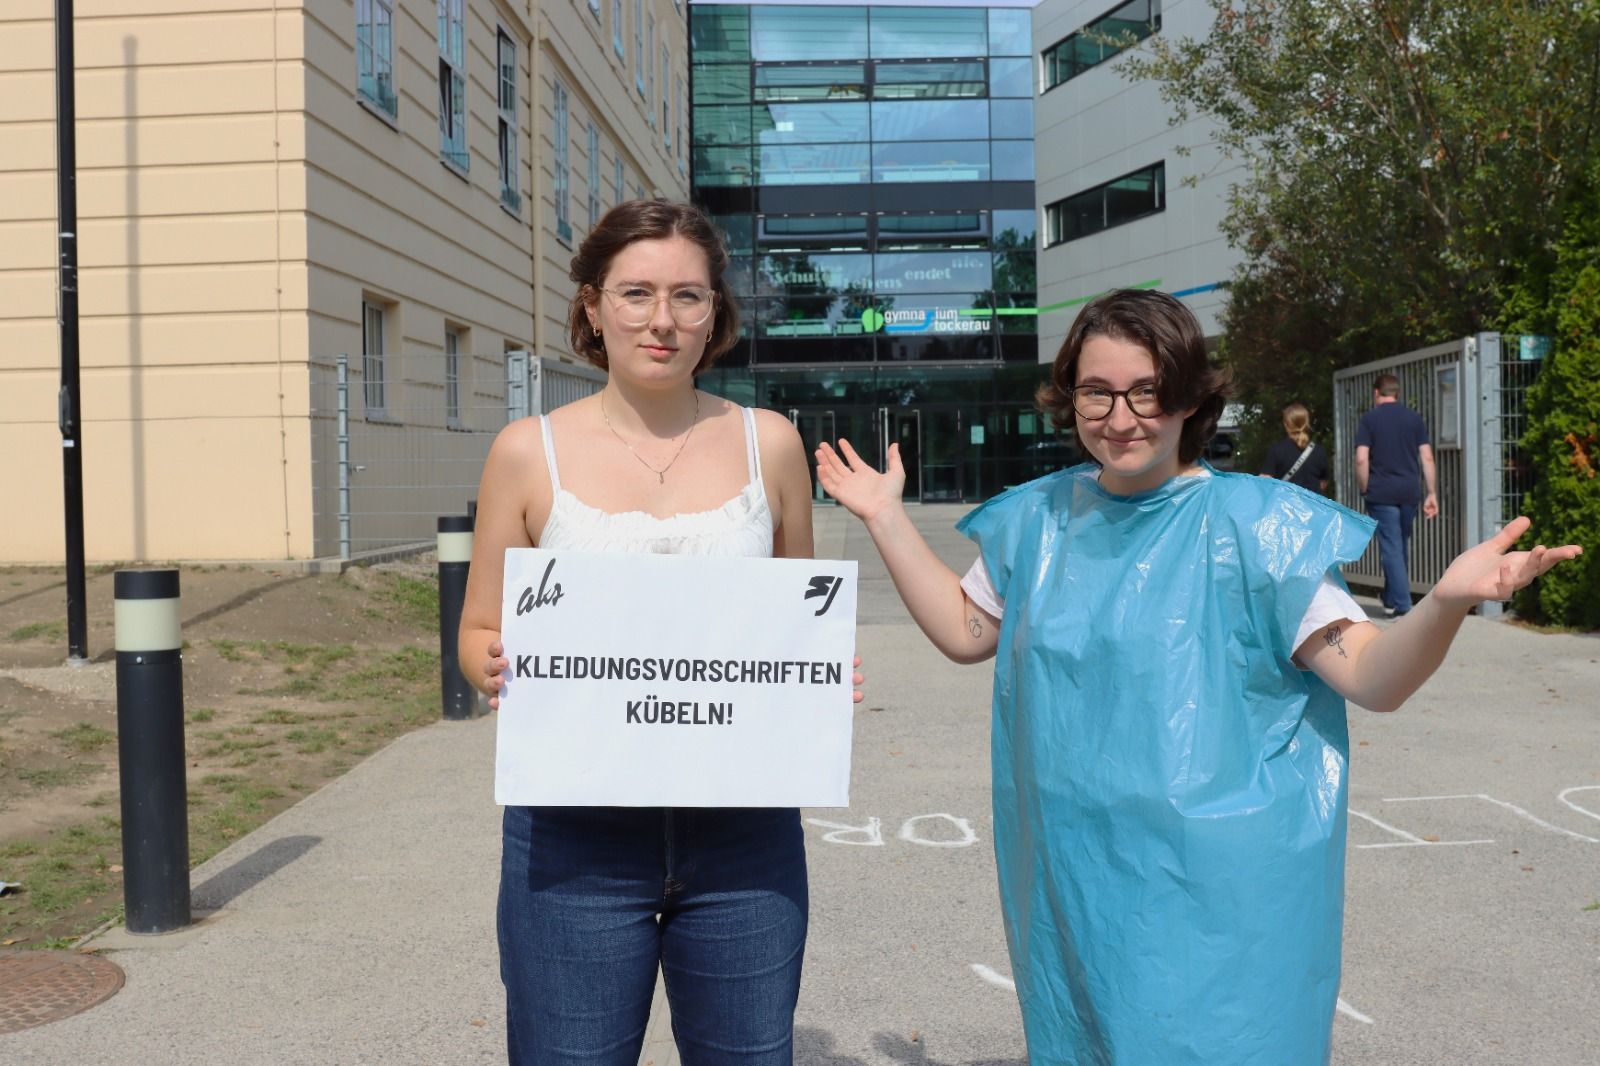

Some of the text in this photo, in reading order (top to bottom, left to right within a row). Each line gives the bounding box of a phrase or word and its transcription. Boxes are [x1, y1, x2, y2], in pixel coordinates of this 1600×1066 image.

[904, 267, 951, 281] endet
[516, 654, 843, 686] KLEIDUNGSVORSCHRIFTEN
[626, 694, 734, 726] KÜBELN!
